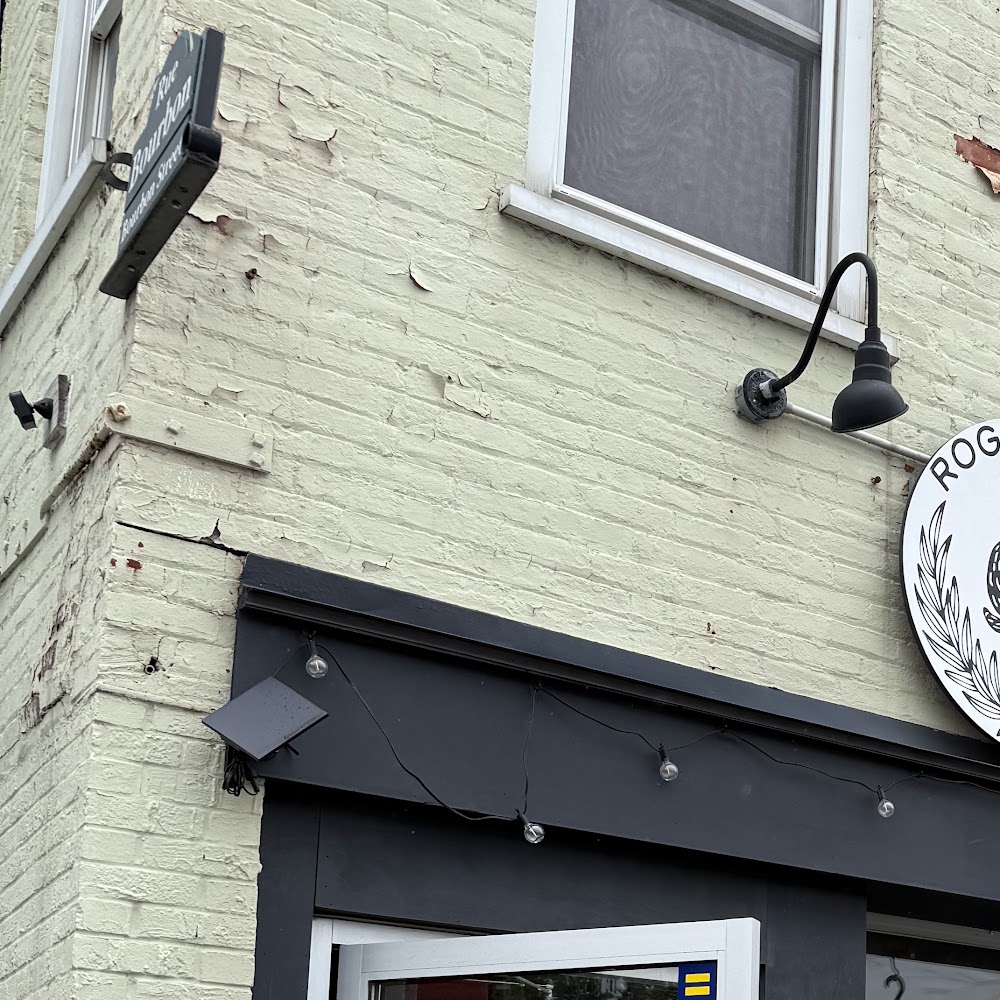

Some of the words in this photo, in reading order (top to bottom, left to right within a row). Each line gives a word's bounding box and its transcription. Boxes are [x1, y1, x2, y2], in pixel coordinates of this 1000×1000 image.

[155, 60, 179, 110] Rue
[128, 75, 192, 193] Bourbon
[121, 182, 155, 242] Bourbon
